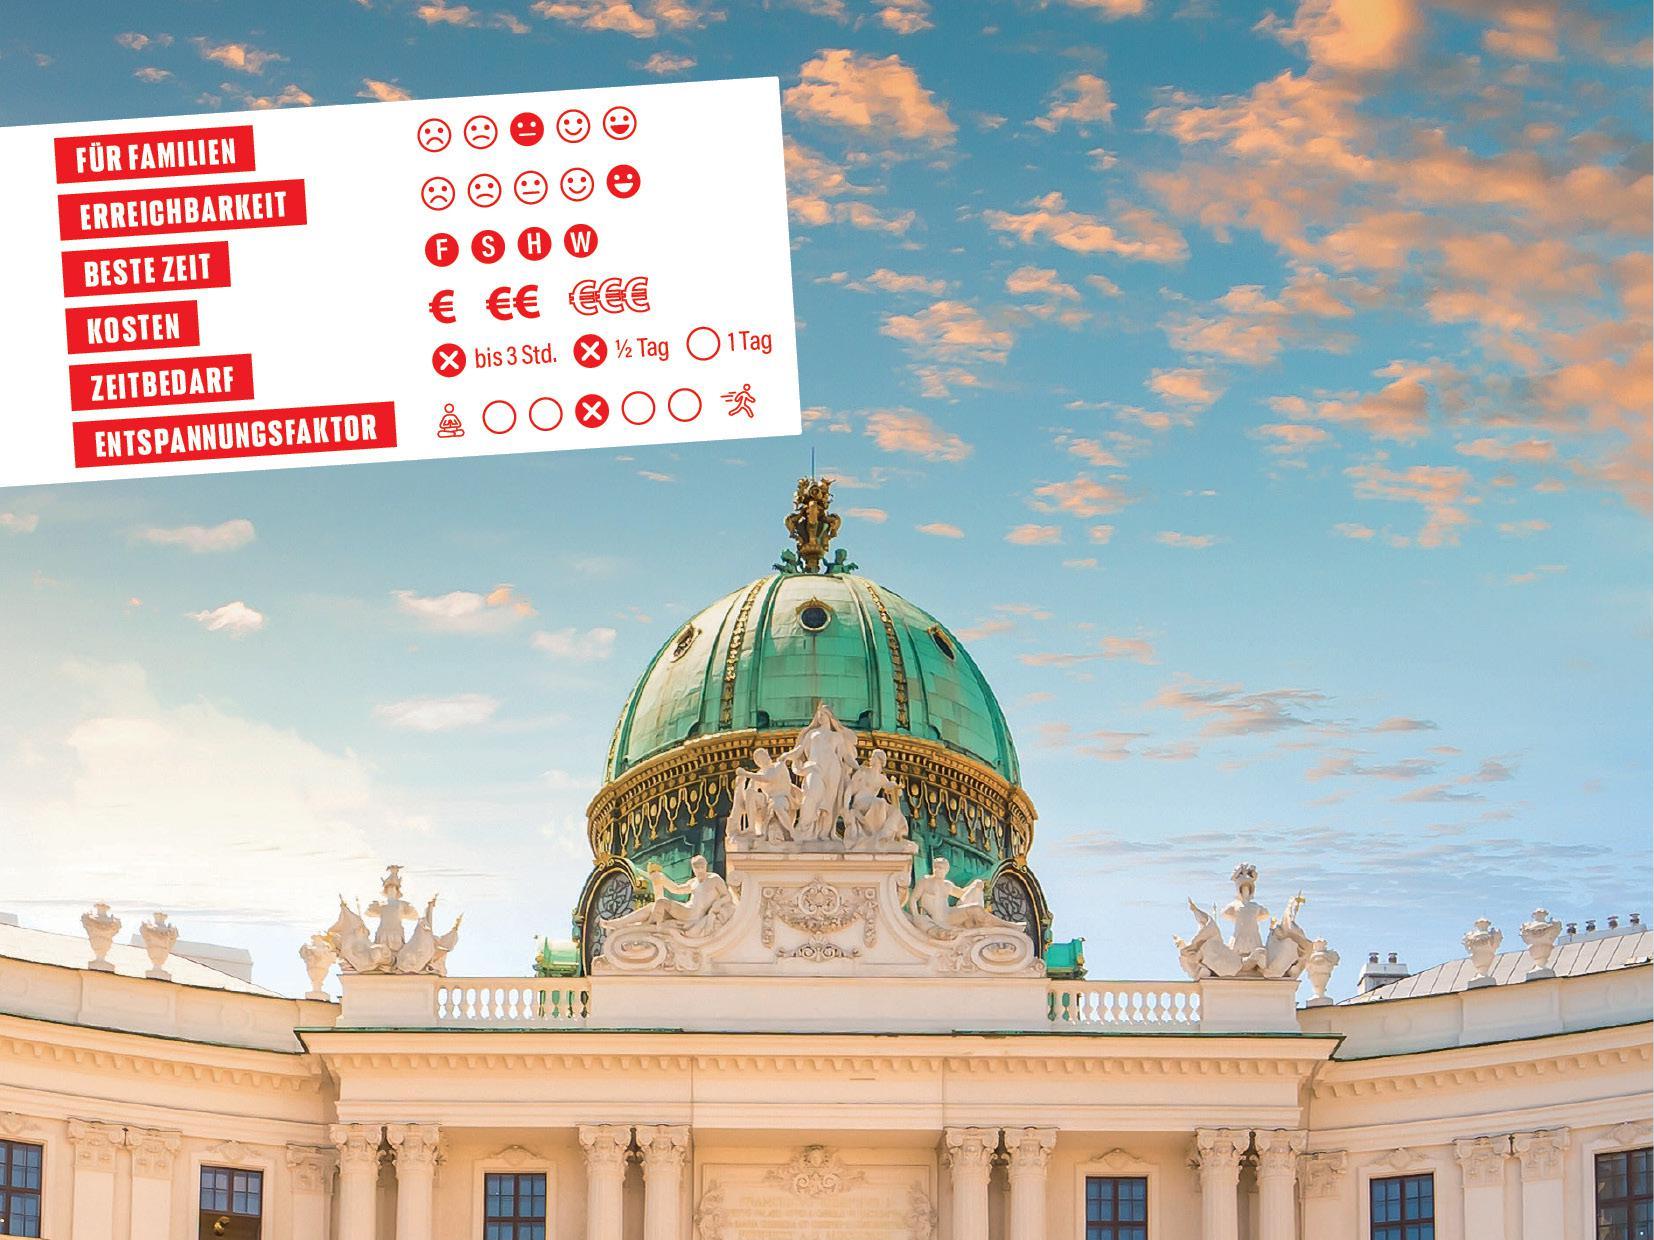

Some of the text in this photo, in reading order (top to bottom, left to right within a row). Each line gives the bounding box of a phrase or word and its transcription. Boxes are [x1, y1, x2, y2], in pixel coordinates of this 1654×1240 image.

[76, 138, 235, 173] FÜR FAMILIEN
[80, 191, 286, 230] ERREICHBARKEIT
[85, 254, 210, 287] BESTE ZEIT
[87, 313, 179, 344] KOSTEN
[728, 330, 773, 354] 1 Tag
[475, 343, 557, 369] bis 3 Std.
[636, 337, 670, 362] Tag
[91, 366, 233, 401] ZEITBEDARF
[96, 414, 377, 457] ENTSPANNUNGSFAKTOR
